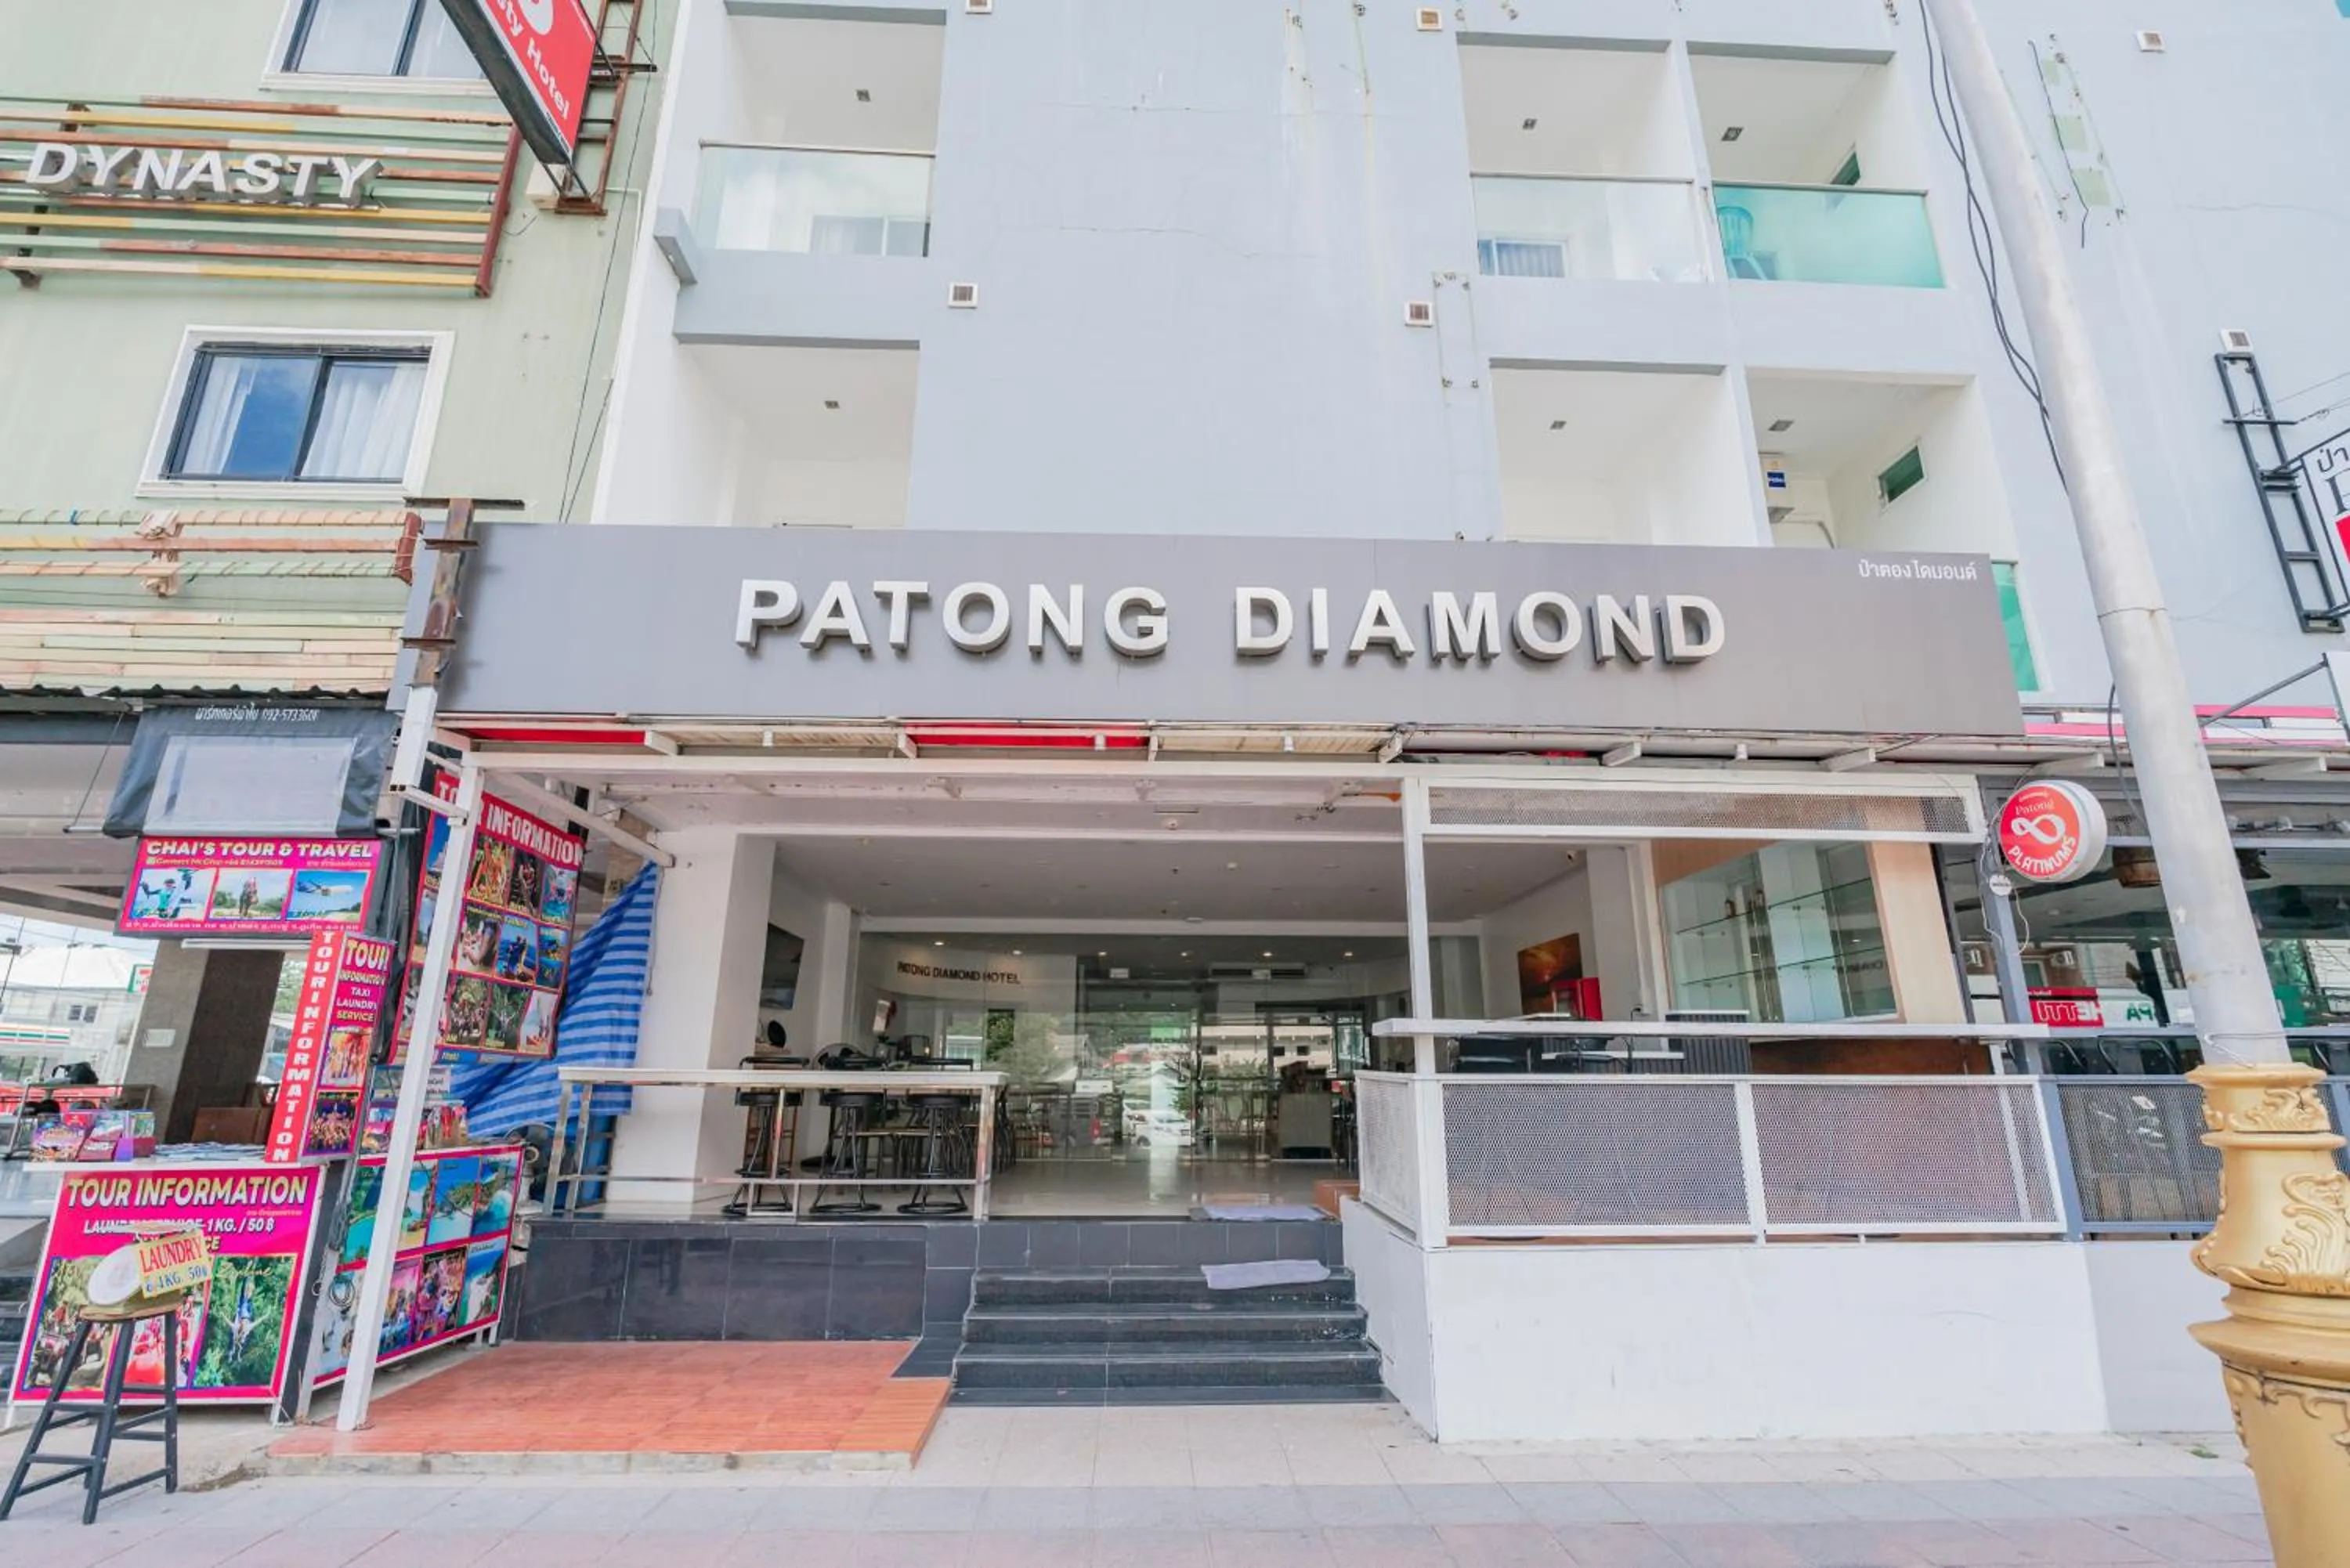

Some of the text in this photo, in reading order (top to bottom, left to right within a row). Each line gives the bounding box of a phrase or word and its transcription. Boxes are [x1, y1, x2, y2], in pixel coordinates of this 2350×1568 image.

[526, 37, 570, 120] Hotel
[25, 142, 382, 204] DYNASTY
[735, 579, 1726, 663] PATONG DIAMOND
[146, 840, 373, 858] CHAI'S TOUR & TRAVEL
[351, 986, 371, 997] TAXI
[982, 971, 1021, 985] HOTEL
[337, 1010, 375, 1022] SERVICE
[67, 1176, 309, 1208] TOUR INFORMATION
[139, 1237, 203, 1274] LAUNDRY
